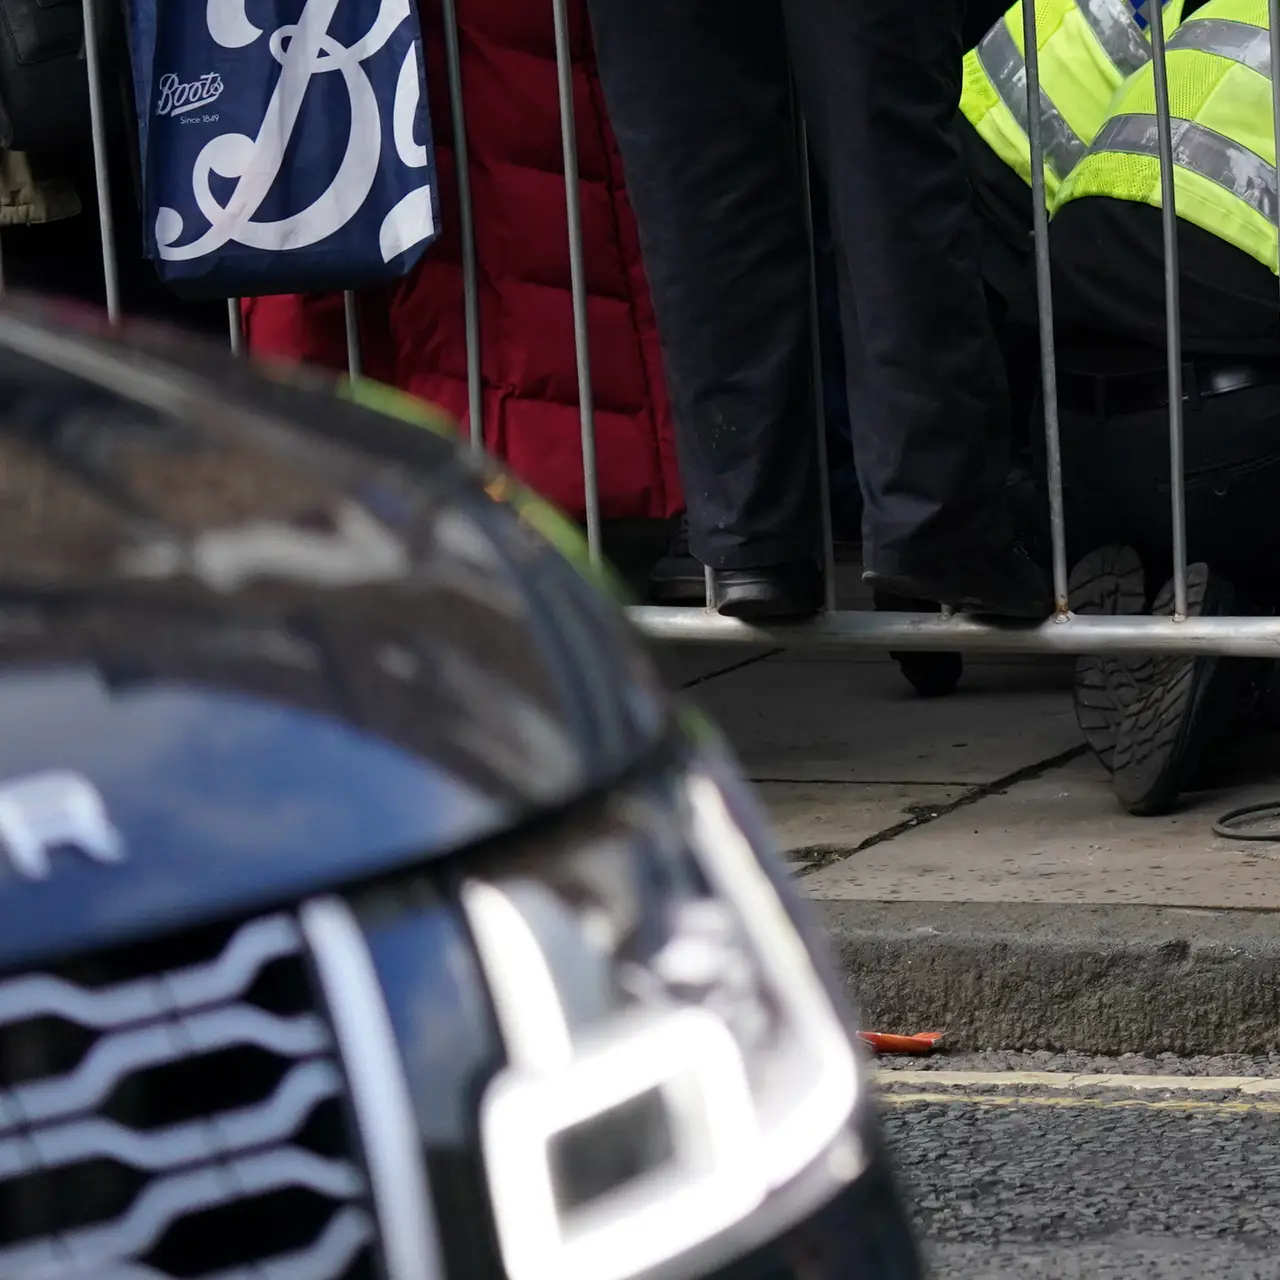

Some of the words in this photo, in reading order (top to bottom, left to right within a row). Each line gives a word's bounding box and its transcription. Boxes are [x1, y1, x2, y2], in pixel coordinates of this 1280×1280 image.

[156, 72, 224, 117] Boots
[180, 116, 201, 124] Since
[202, 114, 220, 123] 1849
